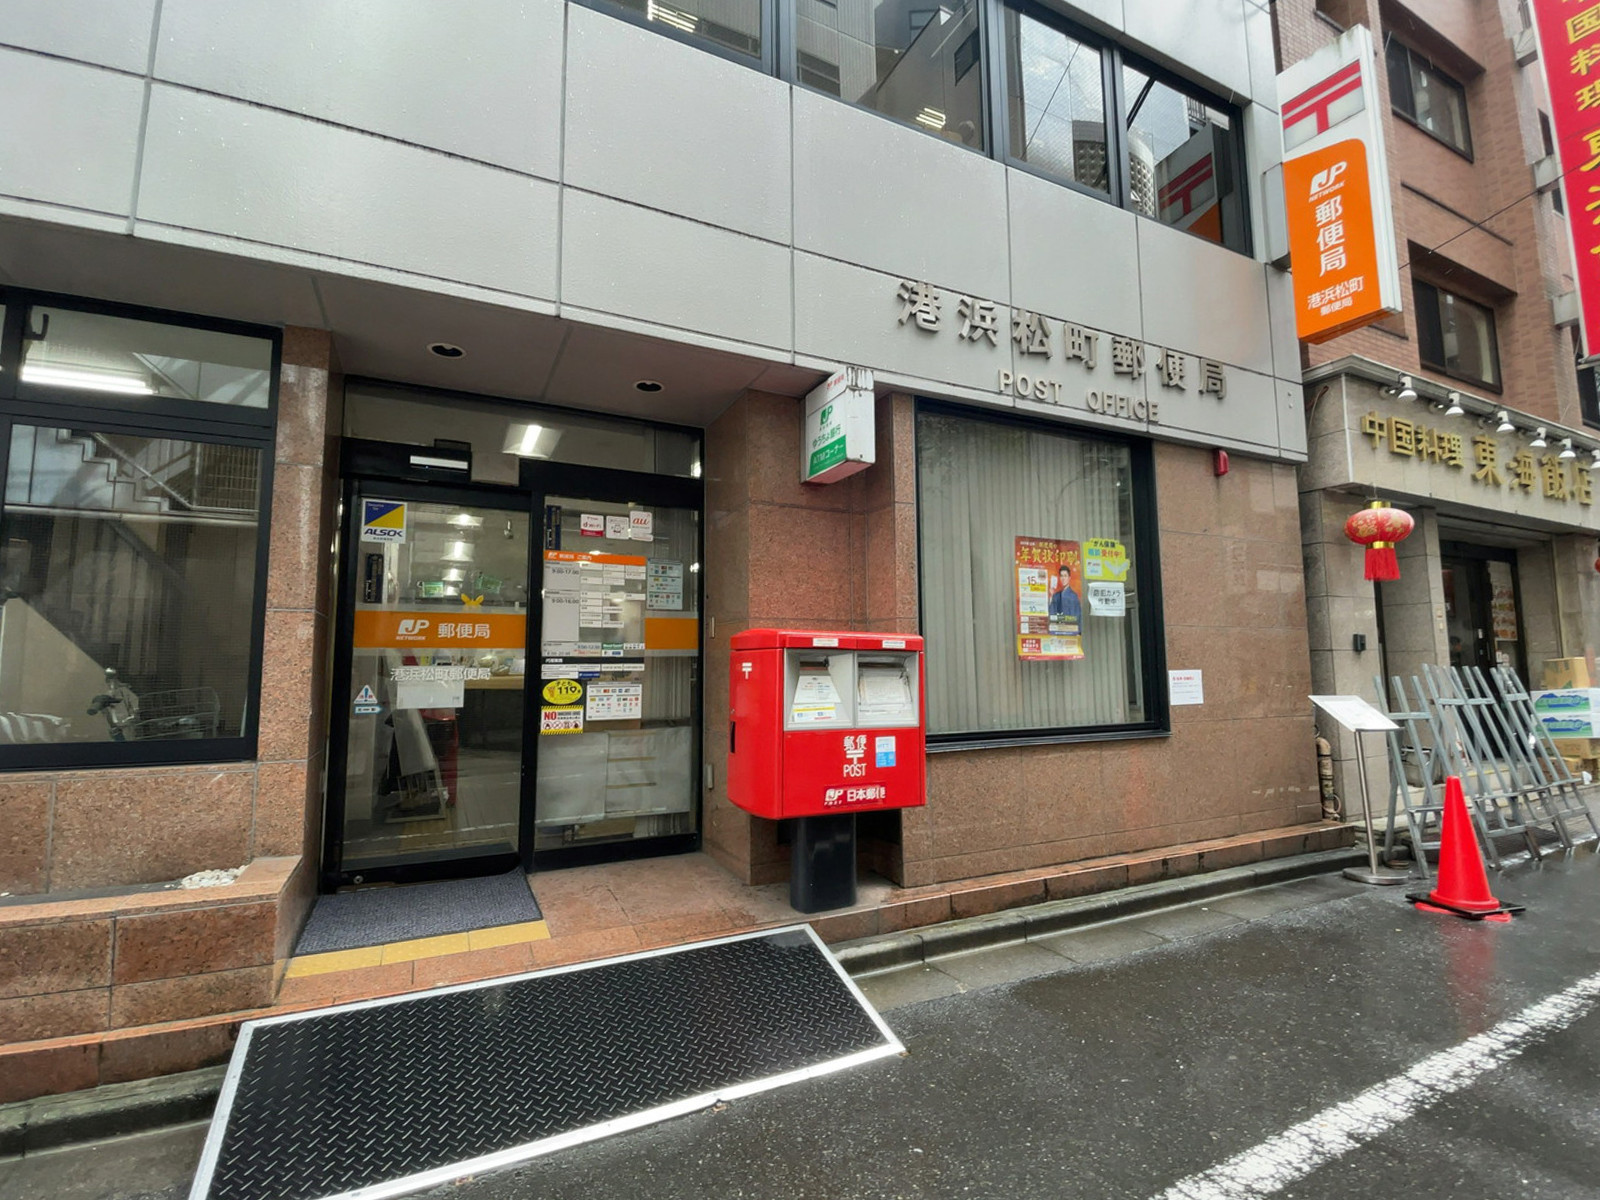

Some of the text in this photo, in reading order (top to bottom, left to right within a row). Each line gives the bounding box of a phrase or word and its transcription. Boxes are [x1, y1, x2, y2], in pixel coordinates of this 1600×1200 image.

[1310, 161, 1347, 195] JP
[1315, 195, 1347, 277] 郵便局
[1307, 276, 1364, 310] 港浜松町
[1320, 296, 1353, 317] 郵便局
[897, 280, 1228, 401] 港浜松町郵便局
[998, 369, 1159, 424] POST OFFICE
[1361, 411, 1594, 506] 中国料理 東海飯店
[632, 517, 650, 526] au
[364, 528, 403, 537] ALSOK
[397, 619, 430, 635] JP
[438, 622, 491, 639] 郵便局
[544, 711, 557, 721] NO
[843, 734, 867, 751] 郵便
[843, 763, 867, 778] POST
[846, 785, 886, 802] 日本郵便
